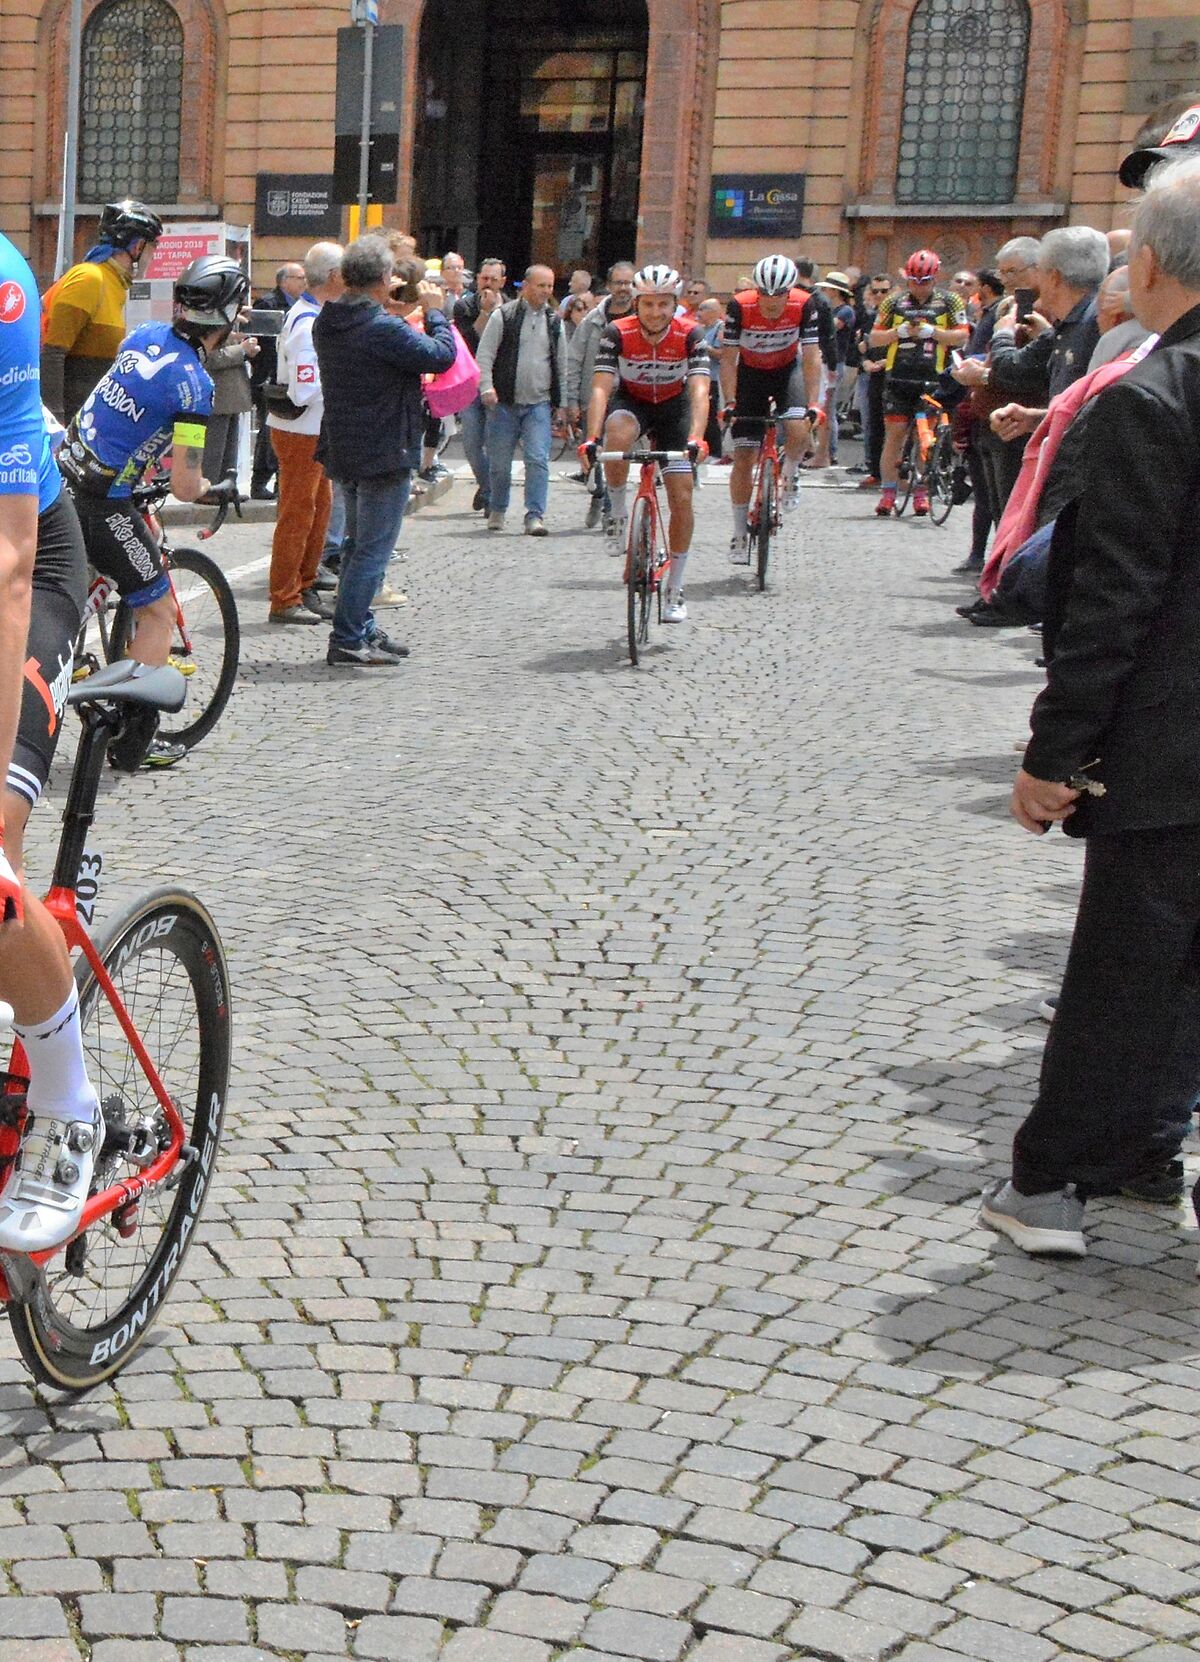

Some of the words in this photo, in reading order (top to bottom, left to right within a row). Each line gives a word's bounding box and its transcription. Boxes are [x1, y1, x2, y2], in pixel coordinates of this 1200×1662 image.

[749, 190, 765, 201] La
[766, 188, 798, 205] Cassa
[167, 251, 192, 259] TAPPA
[96, 376, 145, 423] PASSION
[9, 468, 37, 484] d'Italia
[76, 854, 103, 926] 203
[89, 1092, 221, 1366] BONTRAGER
